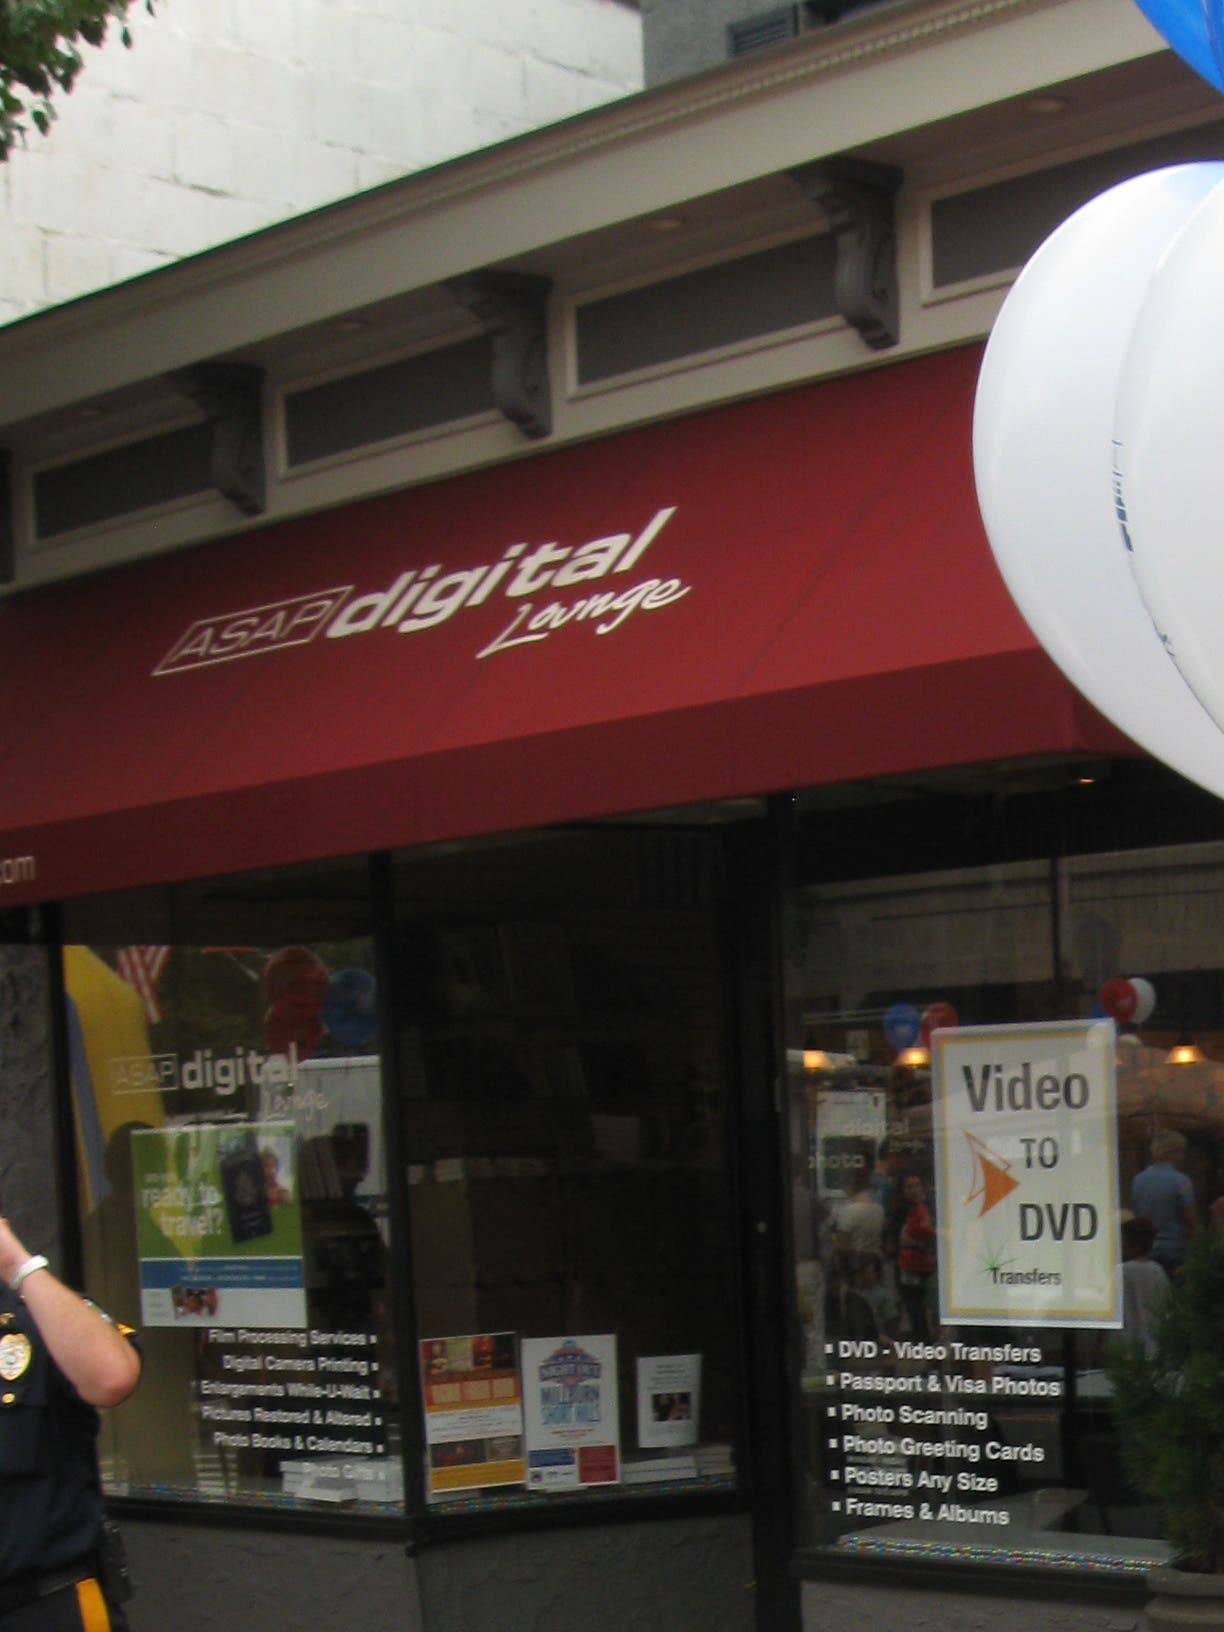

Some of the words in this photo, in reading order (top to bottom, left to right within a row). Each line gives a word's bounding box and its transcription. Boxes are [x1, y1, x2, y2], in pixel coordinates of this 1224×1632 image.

[173, 598, 334, 665] ASAP
[325, 505, 678, 638] digital
[474, 576, 692, 660] Lounge
[181, 1042, 299, 1096] digital
[962, 1062, 1090, 1112] Video
[1019, 1137, 1059, 1169] TO
[1019, 1203, 1099, 1241] DVD
[992, 1266, 1062, 1285] Transfers
[208, 1329, 236, 1344] Film
[238, 1330, 308, 1348] Processing
[309, 1330, 367, 1346] Services
[839, 1341, 877, 1358] DVD
[894, 1342, 946, 1360] Video
[951, 1343, 1042, 1362] Transfers
[222, 1355, 262, 1372] Digital
[264, 1356, 316, 1371] Camera
[318, 1357, 369, 1376] Printing
[840, 1373, 922, 1394] Passport
[927, 1375, 942, 1392] &
[945, 1375, 986, 1393] Visa
[992, 1377, 1062, 1397] Photos
[202, 1406, 252, 1421] Pictures
[253, 1408, 310, 1424] Restored
[313, 1410, 323, 1425] &
[325, 1410, 372, 1426] Altered
[841, 1404, 895, 1423] Photo
[899, 1406, 988, 1430] Scanning
[213, 1432, 249, 1448] Photo
[251, 1433, 292, 1449] Books
[294, 1436, 304, 1450] &
[306, 1436, 373, 1453] Calendars
[843, 1436, 896, 1454] Photo
[899, 1438, 980, 1462] Greeting
[985, 1442, 1045, 1462] Cards
[844, 1467, 913, 1487] Posters
[917, 1471, 952, 1492] Any
[957, 1473, 998, 1492] Size
[845, 1499, 914, 1519] Frames
[919, 1503, 933, 1520] &
[938, 1503, 1010, 1525] Albums
